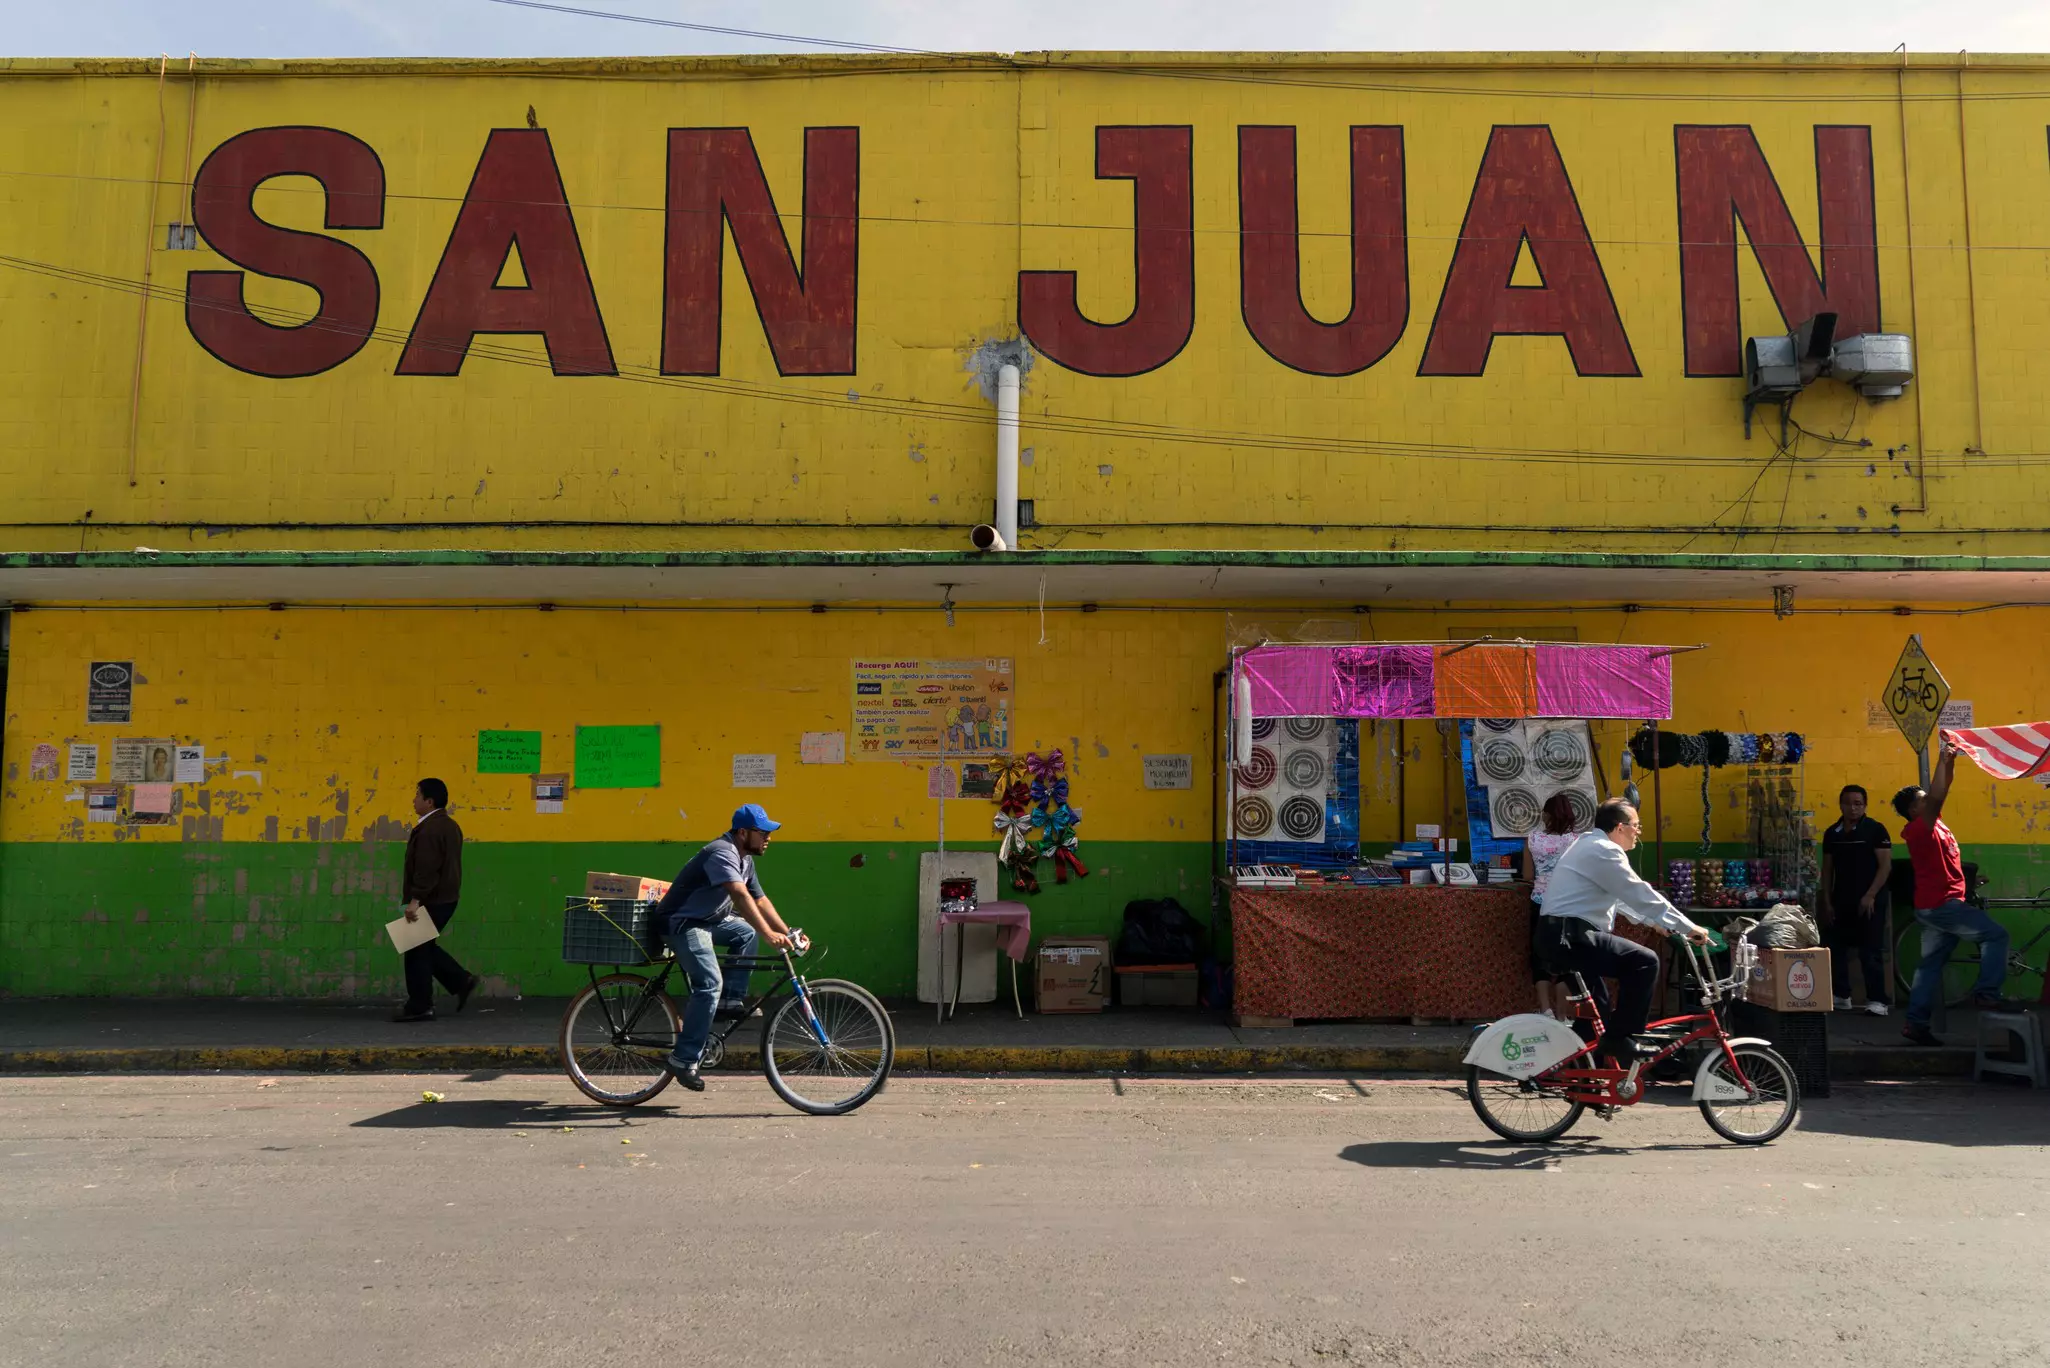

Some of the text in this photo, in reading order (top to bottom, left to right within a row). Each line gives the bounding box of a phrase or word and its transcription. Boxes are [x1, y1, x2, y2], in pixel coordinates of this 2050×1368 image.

[184, 124, 1881, 378] SAN JUAN
[858, 698, 884, 707] nextel
[882, 709, 905, 717] puedes
[884, 739, 904, 749] SKY
[1793, 973, 1808, 982] 360
[1501, 1032, 1521, 1061] 6
[1714, 1084, 1735, 1094] 1899
